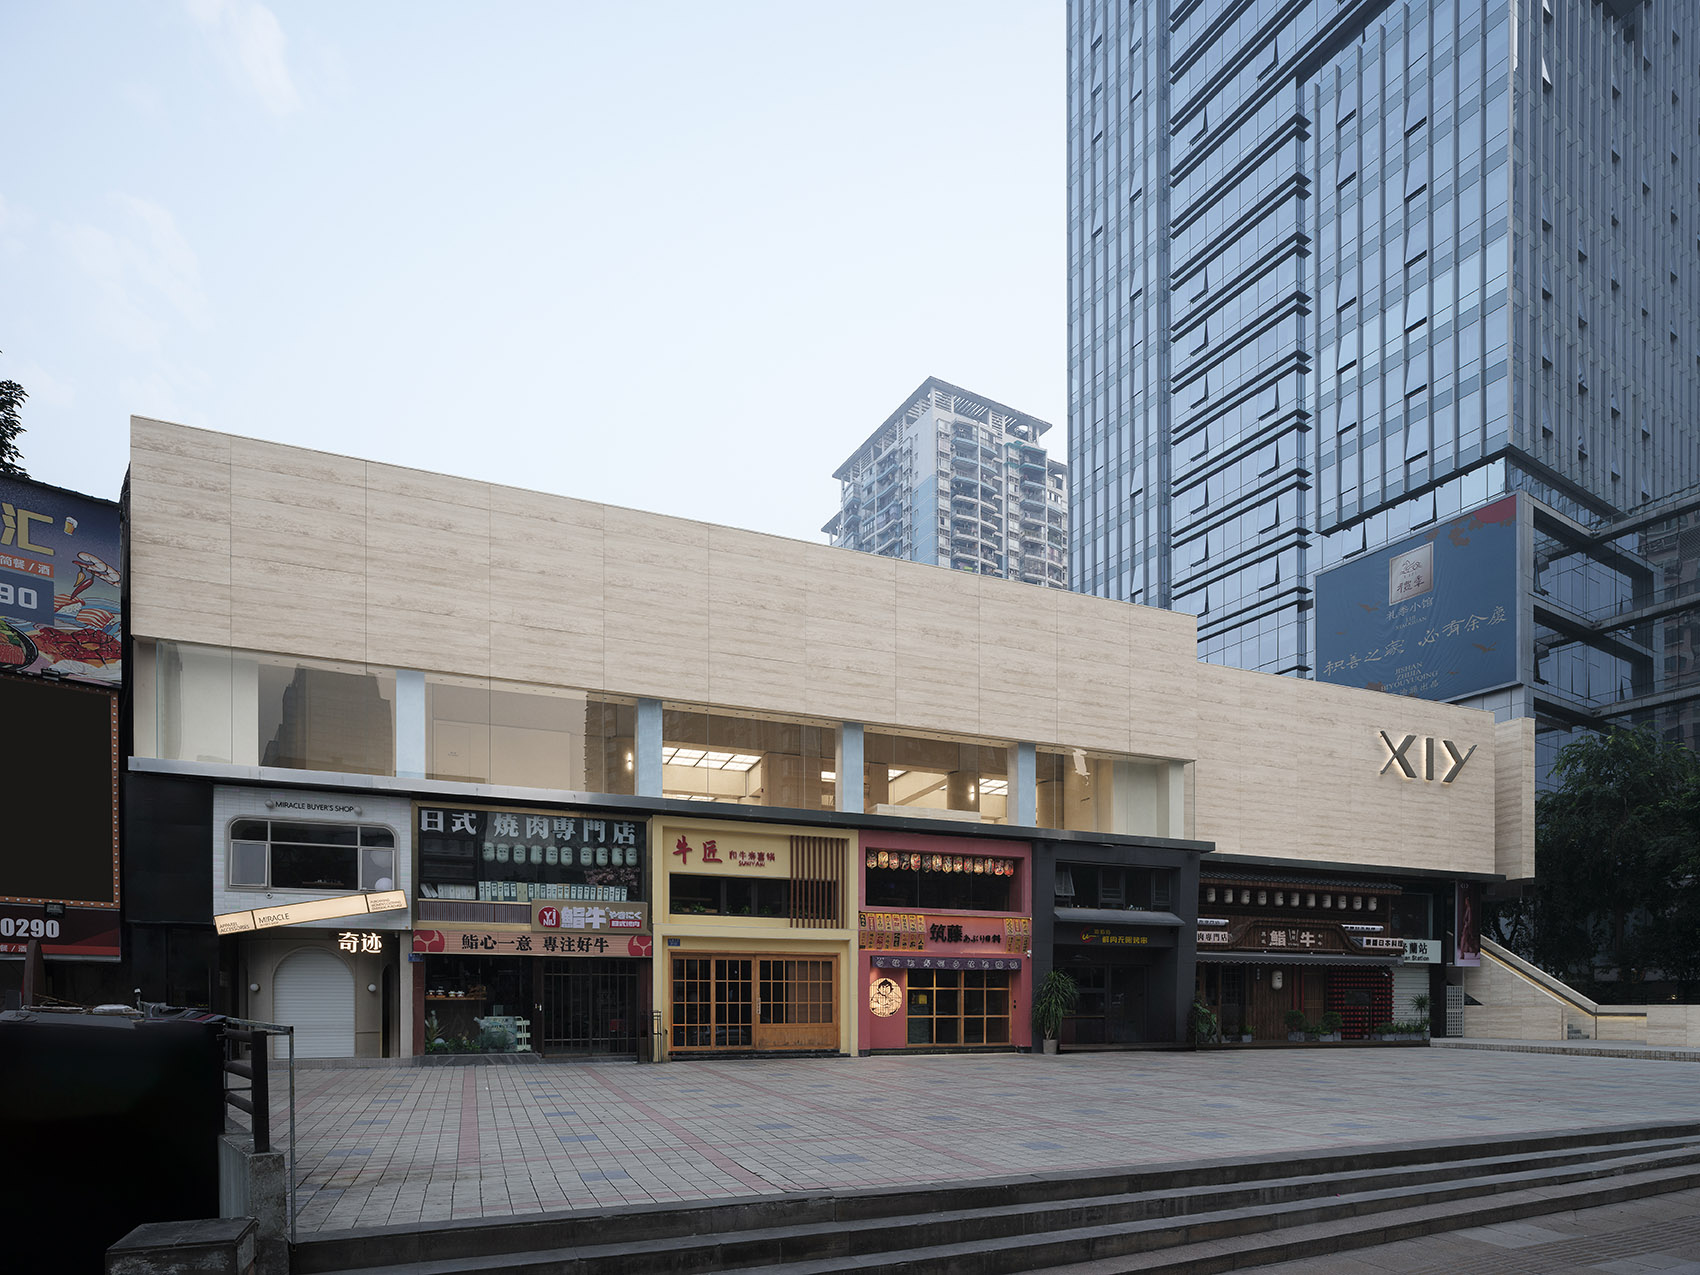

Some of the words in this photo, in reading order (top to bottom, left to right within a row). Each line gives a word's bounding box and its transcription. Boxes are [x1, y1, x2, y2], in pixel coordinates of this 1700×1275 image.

[275, 801, 306, 810] MIRACLE
[306, 803, 334, 812] BUYER'S
[334, 805, 355, 813] SHOP
[258, 912, 290, 924] MIRACLE
[0, 917, 60, 938] 0290
[338, 931, 383, 954] 奇迹
